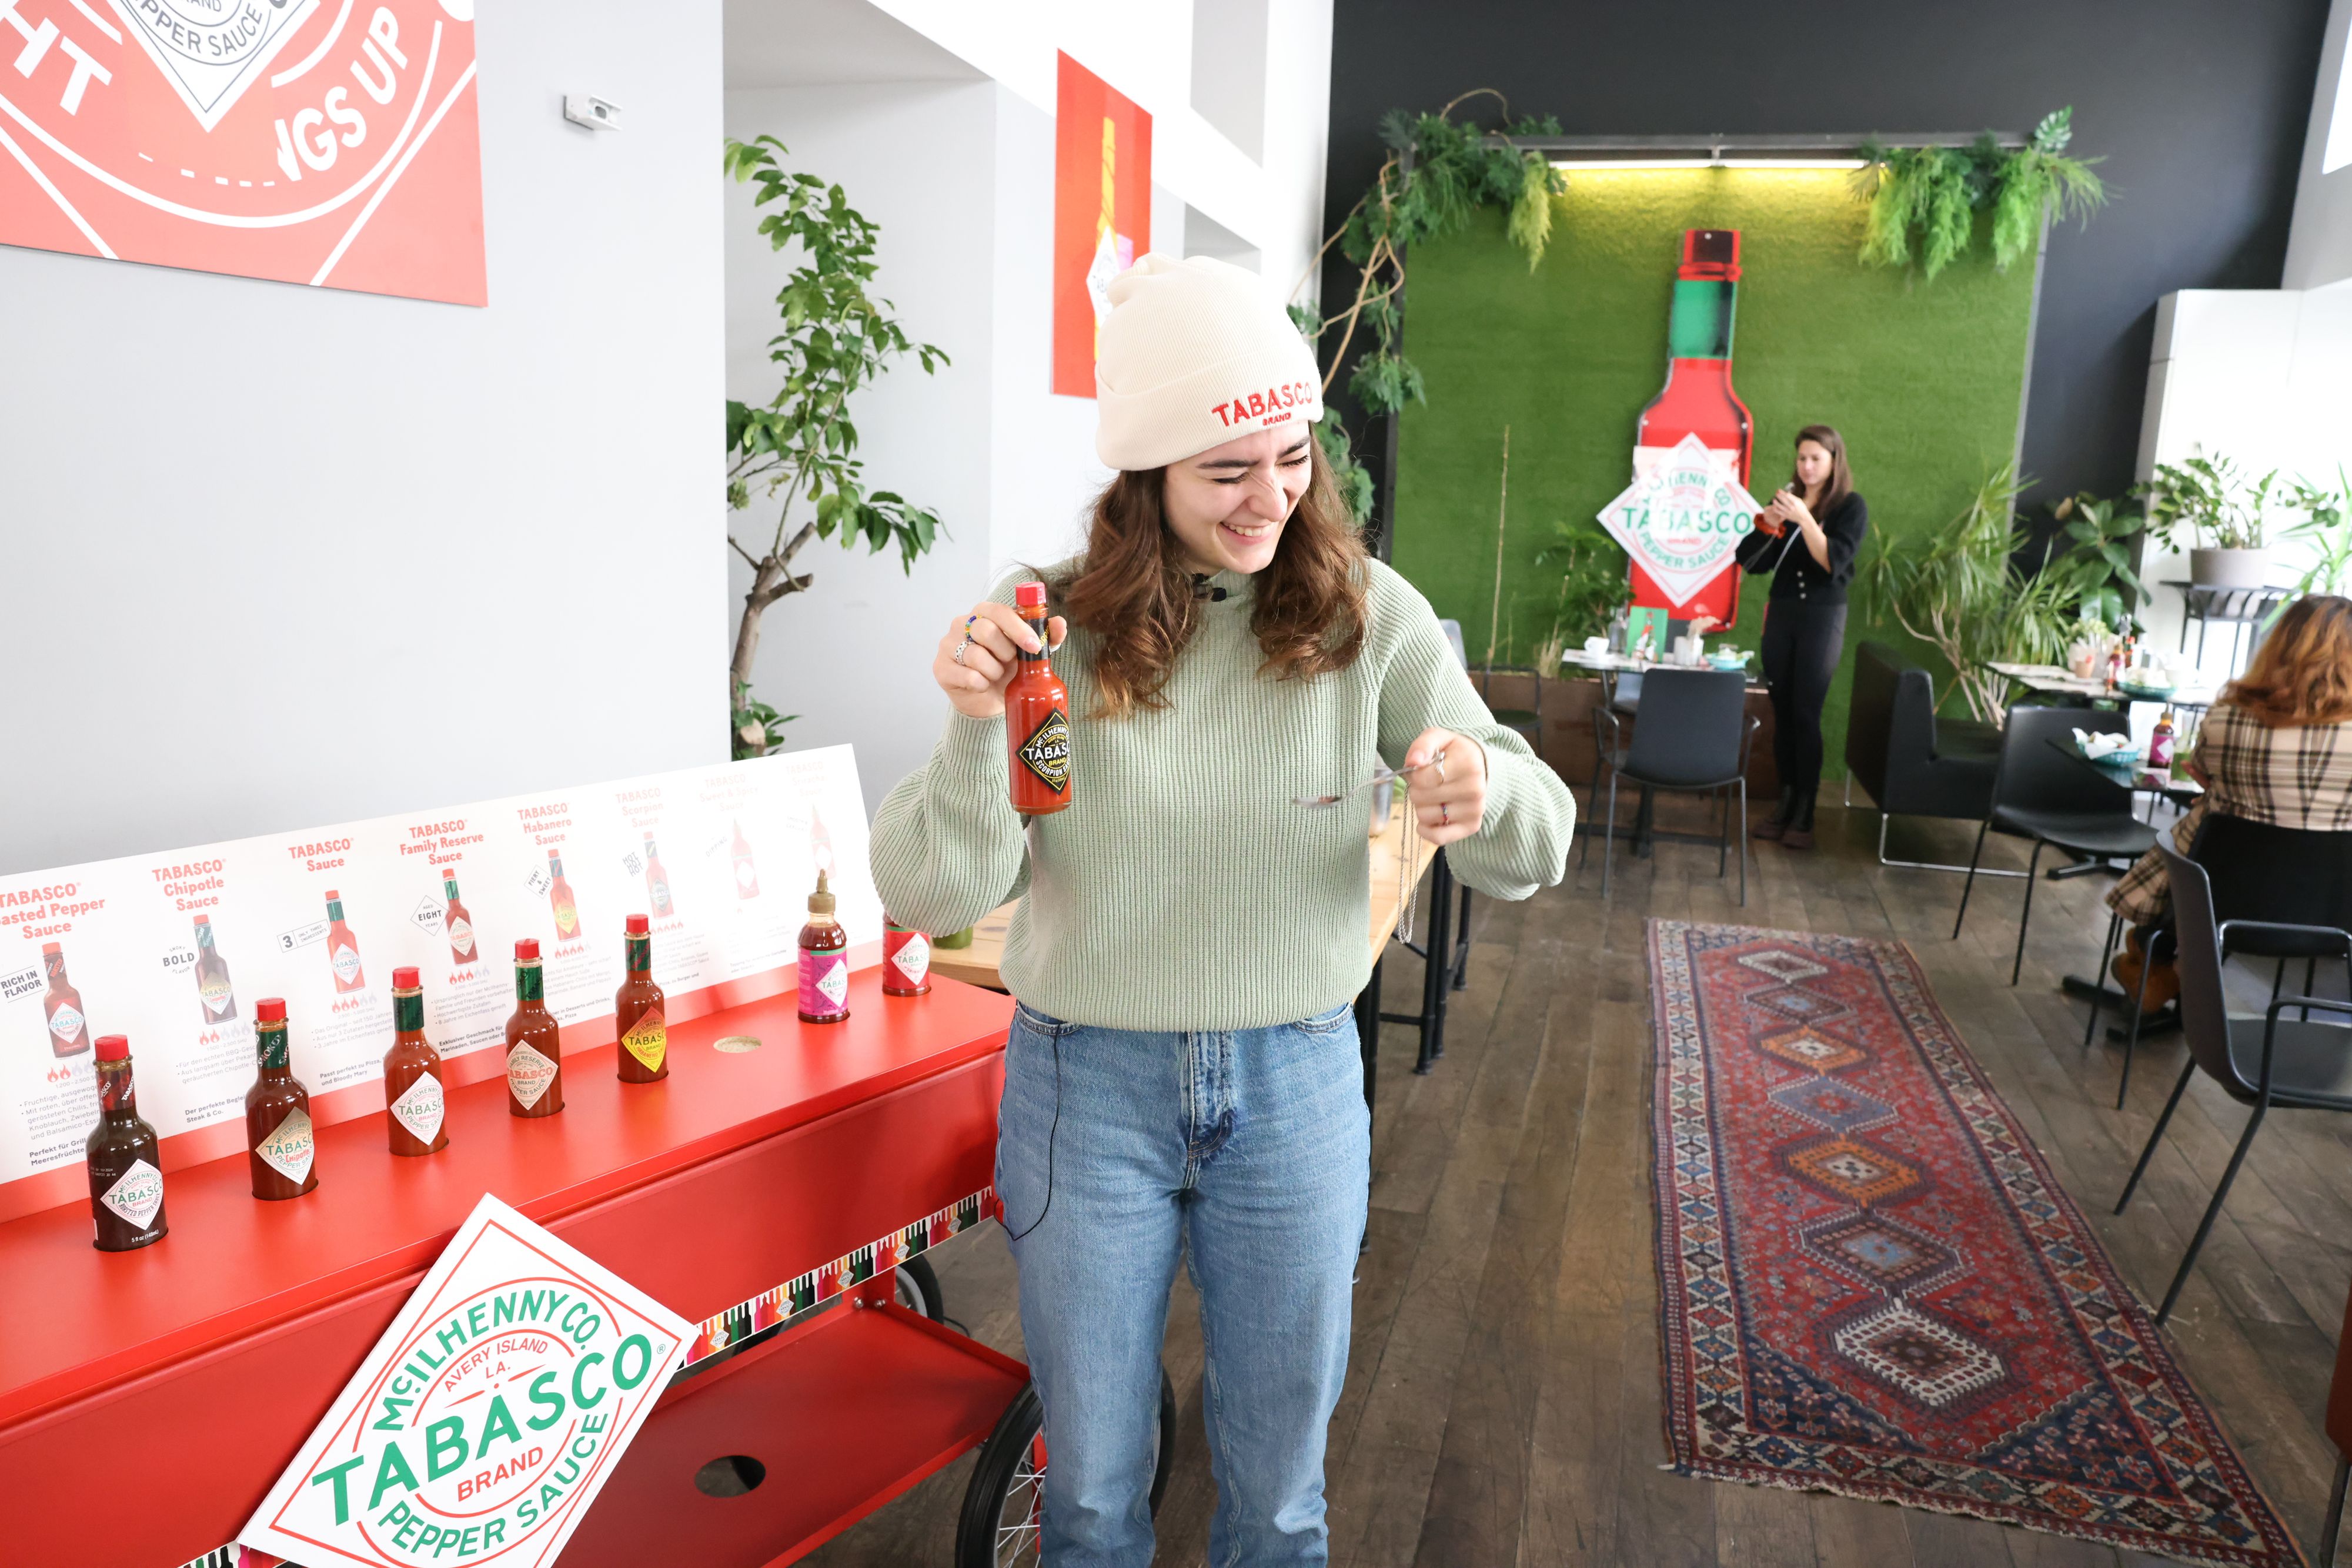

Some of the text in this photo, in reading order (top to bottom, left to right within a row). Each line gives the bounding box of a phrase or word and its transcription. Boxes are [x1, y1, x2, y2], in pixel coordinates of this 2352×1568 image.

[208, 3, 262, 56] SAUCE
[349, 6, 408, 105] UP
[1211, 382, 1312, 426] TABASCO
[1262, 412, 1291, 426] BRAND
[1688, 534, 1730, 569] SAUCE
[1036, 760, 1063, 776] SCORPION
[1048, 757, 1066, 766] BRAND
[616, 788, 661, 804] TABASCO
[517, 803, 568, 820] TABASCO
[622, 803, 664, 816] Scorpion
[409, 819, 465, 839] TABASCO
[523, 818, 572, 834] Habanero
[632, 817, 659, 828] Sauce
[400, 834, 484, 856] Family Reserve
[535, 833, 566, 845] Sauce
[288, 838, 351, 860] TABASCO
[307, 858, 345, 872] Sauce
[428, 852, 462, 865] Sauce
[152, 860, 222, 882] TABASCO
[529, 870, 540, 887] FIERY
[164, 876, 224, 897] Chipotle
[539, 877, 552, 895] SWEET
[0, 883, 76, 908] TABASCO
[176, 896, 219, 911] Sauce
[0, 899, 105, 925] asted Pepper
[418, 910, 442, 921] EIGHT
[22, 922, 72, 939] Sauce
[299, 924, 323, 938] ONLY THREE
[301, 928, 328, 942] INGREDIENTS
[282, 935, 293, 948] 3
[162, 952, 195, 967] BOLD
[172, 966, 191, 974] FLAVOR
[1, 970, 38, 989] RICH IN
[4, 979, 42, 998] FLAVOR
[566, 1004, 585, 1012] Desserts
[51, 1016, 82, 1028] TABASCO
[326, 1022, 348, 1032] Original
[343, 1025, 365, 1034] Zutaten
[365, 1018, 393, 1029] hergestellt
[323, 1039, 338, 1048] Jahre
[347, 1030, 376, 1042] Eichenfass
[439, 1036, 465, 1047] Exklusiver
[466, 1028, 495, 1039] Geschmack
[205, 1053, 225, 1062] echten
[258, 1034, 282, 1067] SMOKED
[194, 1062, 220, 1073] langsam
[222, 1058, 235, 1066] über
[320, 1071, 336, 1079] Passt
[336, 1064, 357, 1075] perfekt
[365, 1058, 382, 1066] Pizza,
[521, 1055, 545, 1068] RESERVE
[182, 1069, 224, 1084] geräucherten
[333, 1072, 353, 1082] Bloody
[353, 1070, 368, 1078] Mary
[507, 1066, 553, 1079] ABASCO
[529, 1078, 546, 1095] SAUCE
[24, 1095, 59, 1107] Fruchtige,
[26, 1098, 77, 1116] Mit roten, über
[198, 1100, 225, 1112] perfekte
[28, 1104, 88, 1124] gerösteten Chilis,
[186, 1114, 205, 1123] Steak
[407, 1115, 429, 1129] PEPPER
[419, 1112, 437, 1122] BRAND
[29, 1115, 69, 1132] Knoblauch,
[31, 1130, 45, 1141] und
[29, 1146, 56, 1158] Perfekt
[31, 1148, 85, 1166] Meeresfrüchte
[276, 1155, 300, 1168] PEPPER
[109, 1179, 162, 1204] TABASCO
[118, 1203, 137, 1216] ROASTED
[138, 1206, 154, 1216] PEPPER
[132, 1197, 153, 1207] BRAND
[444, 1338, 548, 1392] AVERY ISLAND
[485, 1362, 512, 1379] LA.
[457, 1446, 543, 1502] BRAND
[378, 1413, 609, 1559] PEPPER SAUCE
